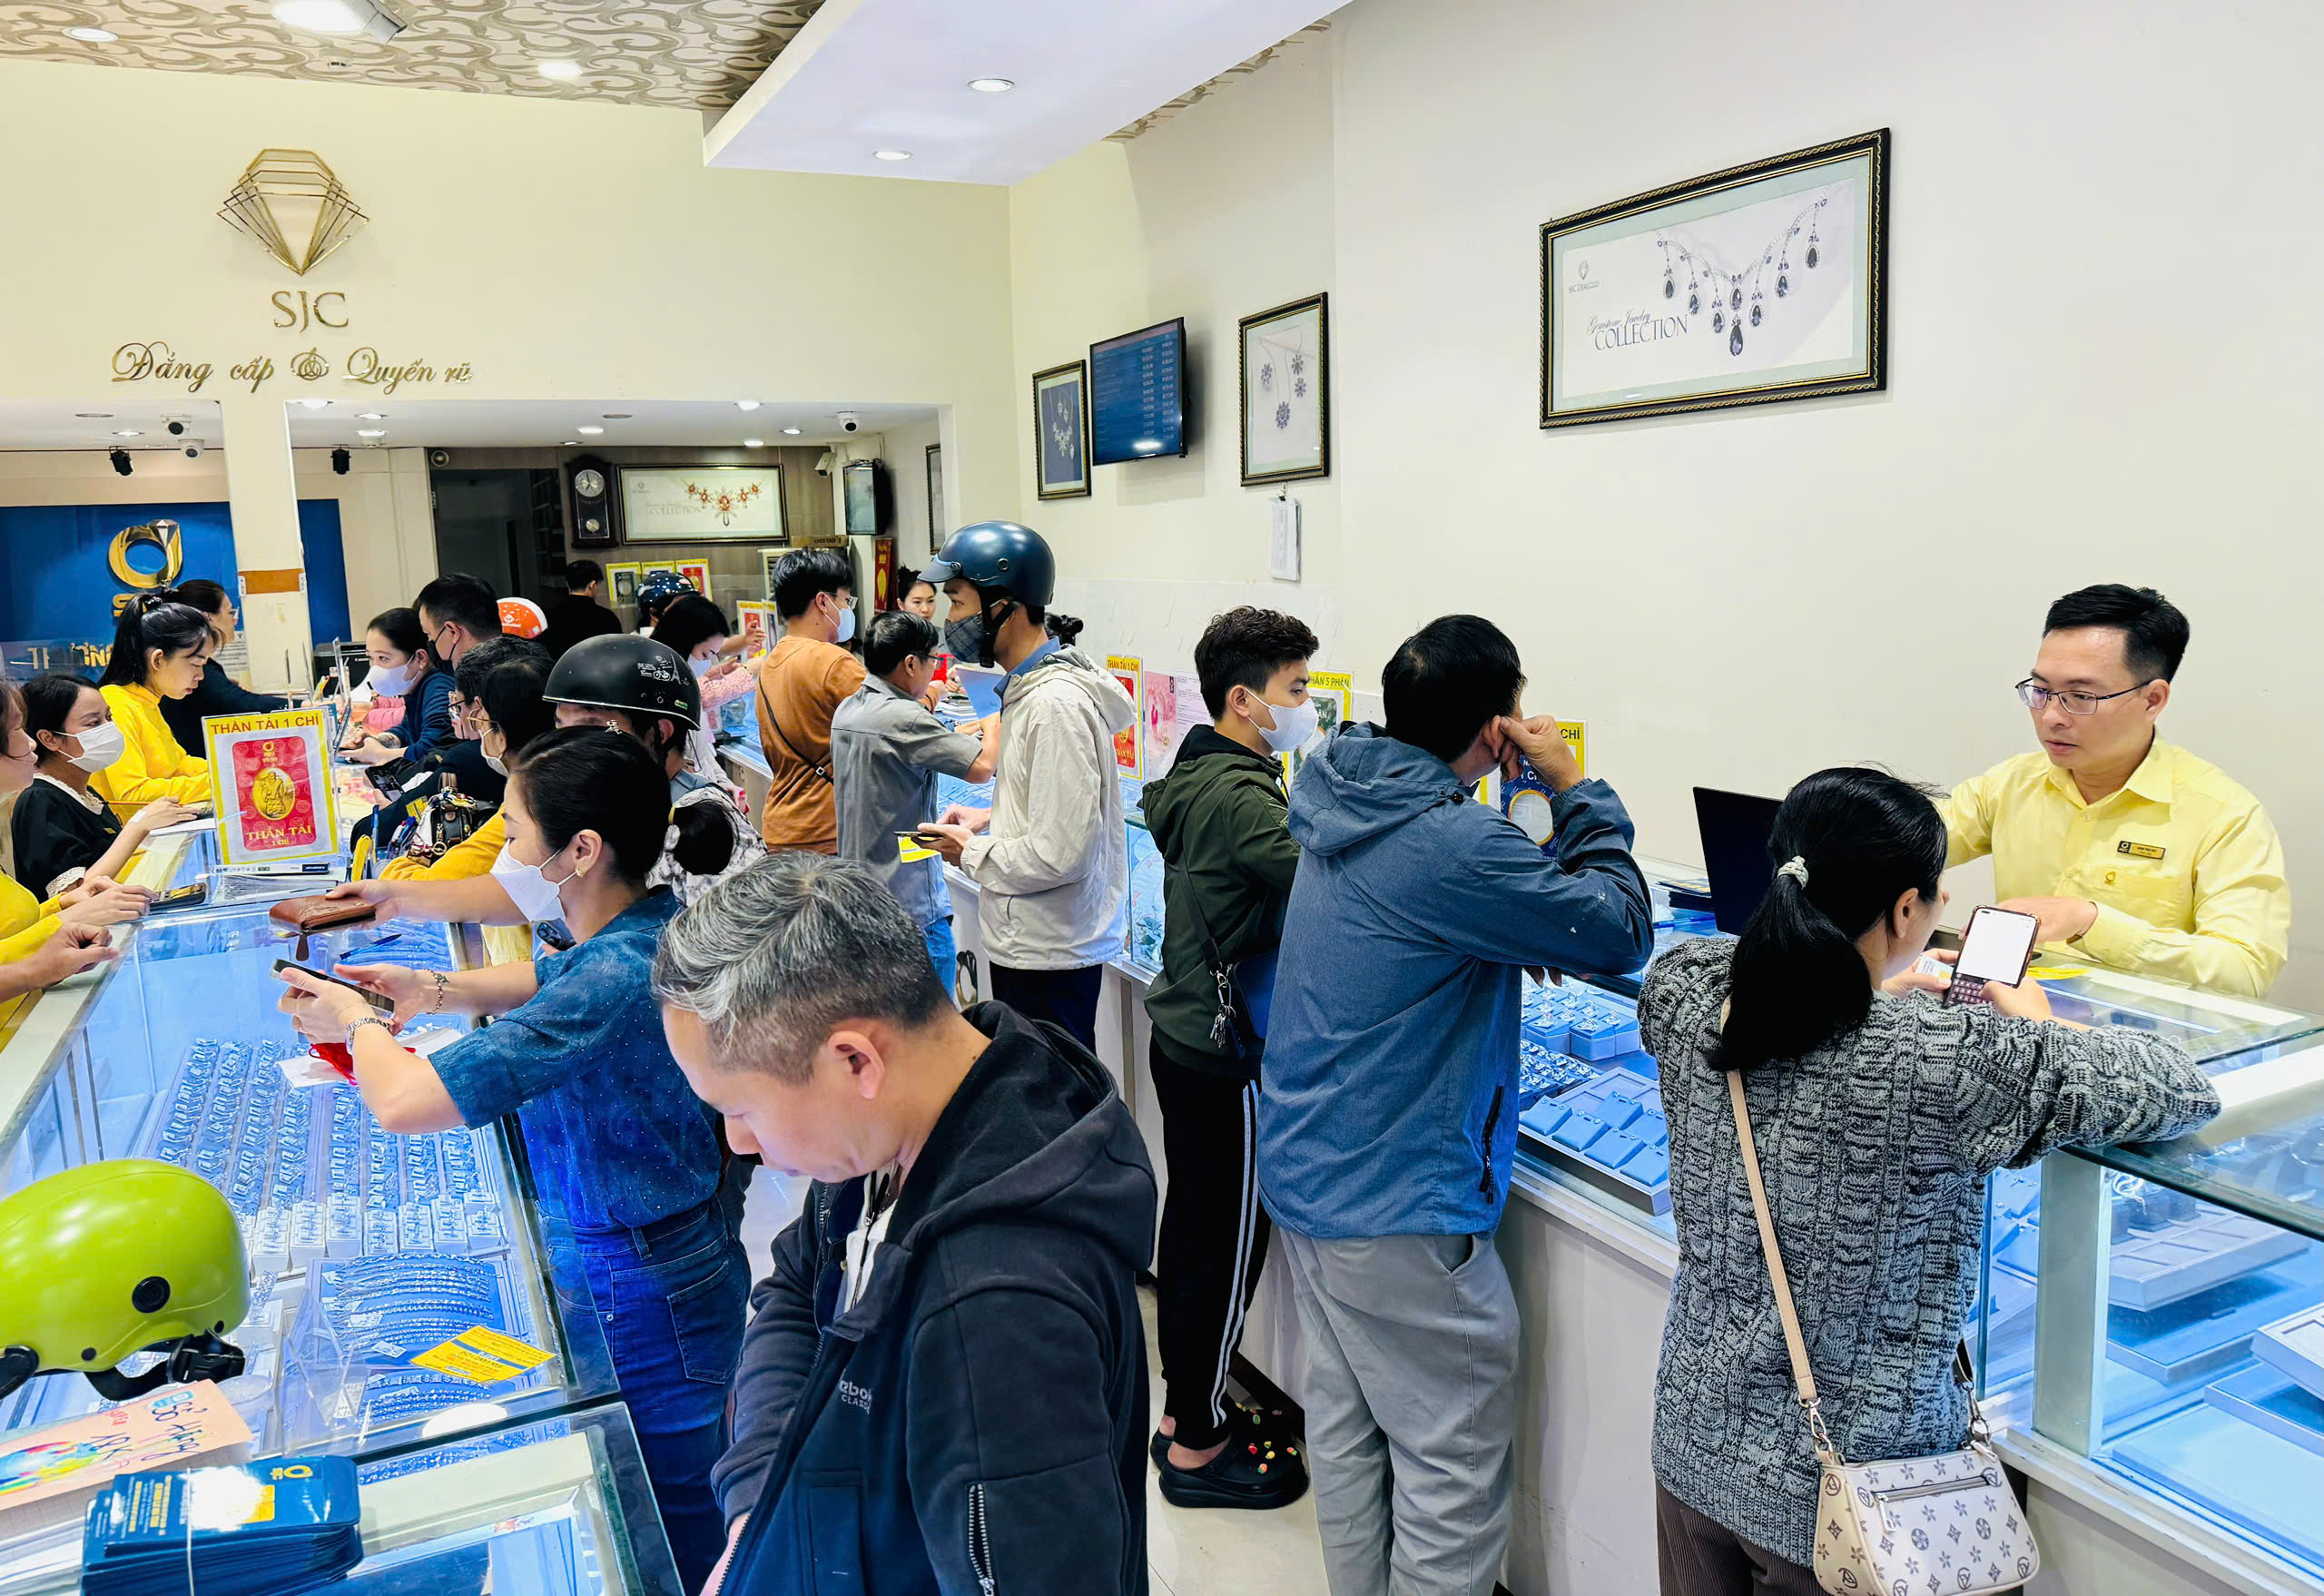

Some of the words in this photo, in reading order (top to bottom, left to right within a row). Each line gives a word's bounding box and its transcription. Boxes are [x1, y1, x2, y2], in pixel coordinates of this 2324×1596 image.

[271, 290, 349, 333] SJC
[1594, 314, 1688, 350] COLLECTION
[111, 340, 213, 393] Đẳng
[229, 355, 275, 393] cấp
[340, 346, 438, 395] Quyến
[256, 716, 279, 730] TÀI
[283, 718, 290, 728] 1
[295, 714, 320, 727] CHỈ
[1561, 726, 1581, 740] CHỈ
[246, 825, 285, 841] THẦN
[288, 823, 312, 836] TÀI
[839, 1380, 872, 1402] ebo
